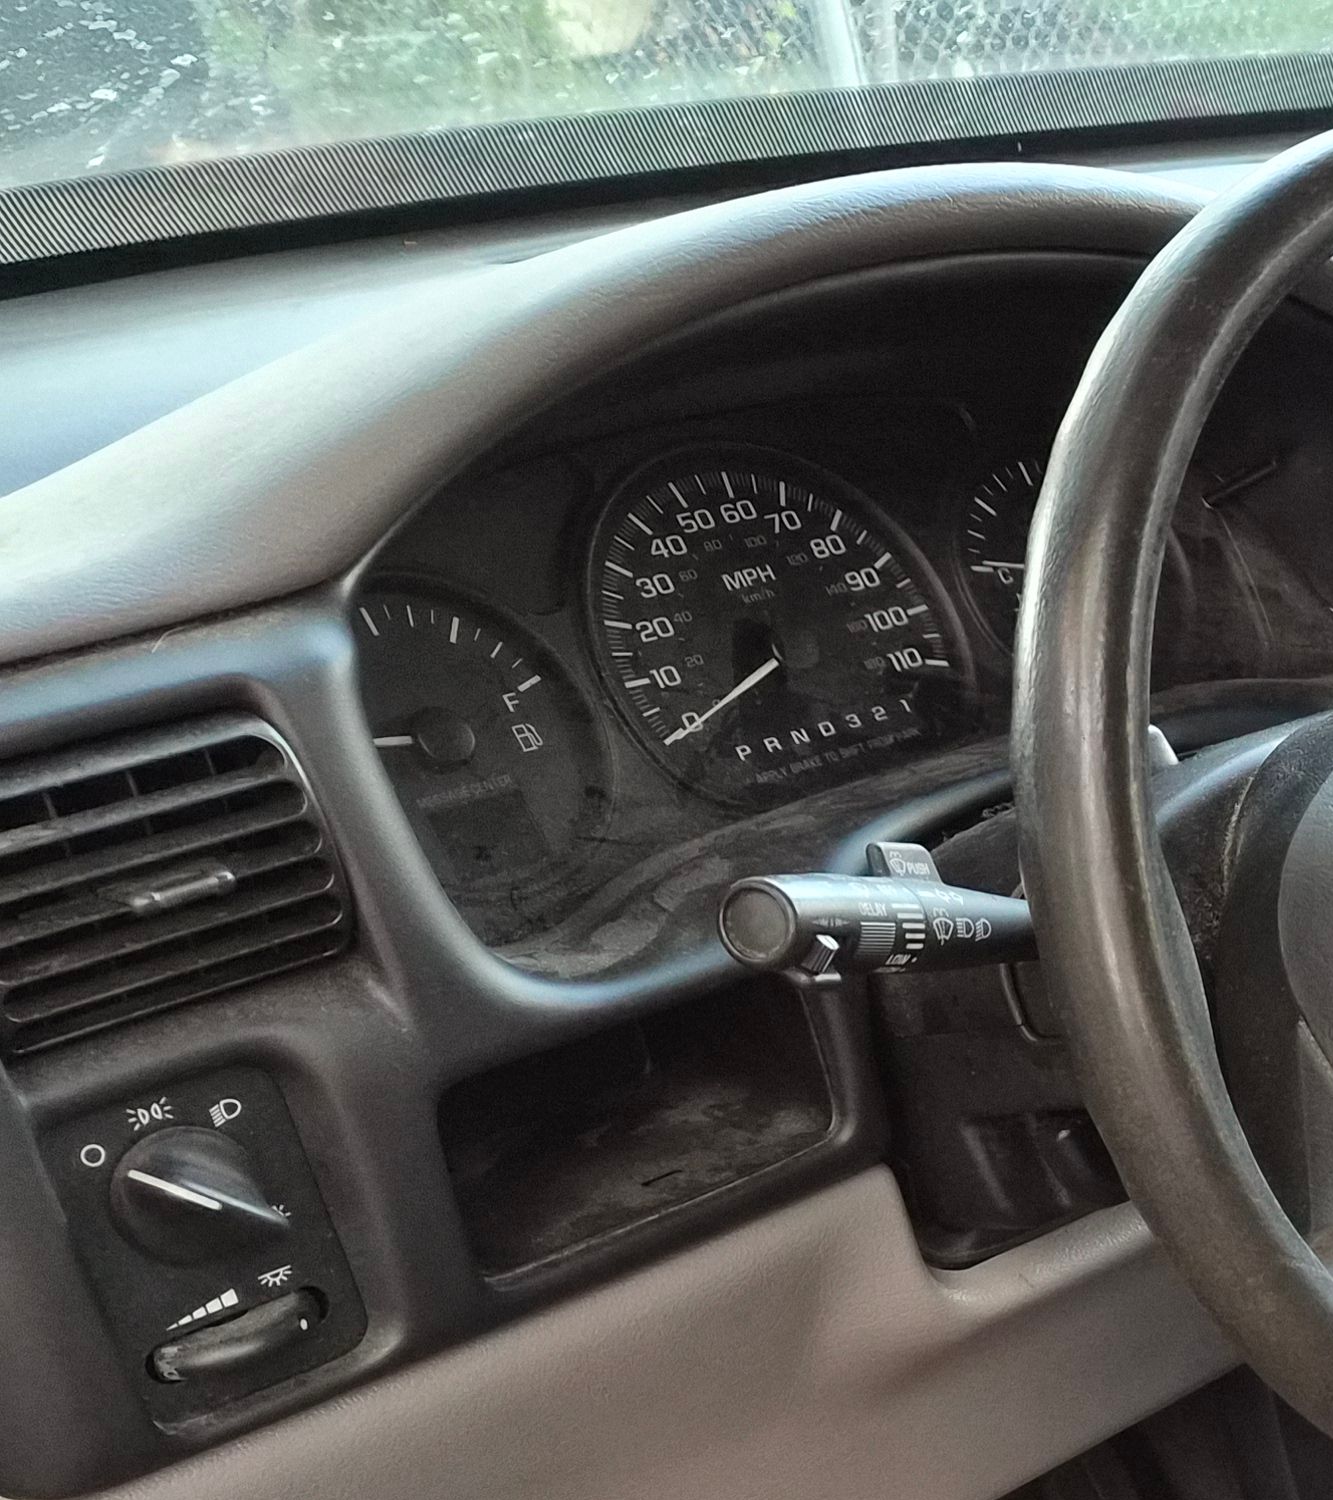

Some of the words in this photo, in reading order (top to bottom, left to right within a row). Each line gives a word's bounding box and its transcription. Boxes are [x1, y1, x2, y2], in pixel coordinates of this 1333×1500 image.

[676, 509, 715, 533] 50
[720, 500, 757, 524] 60
[764, 510, 802, 533] 70
[650, 535, 688, 559] 40
[744, 535, 767, 549] 100
[809, 534, 846, 559] 80
[635, 573, 675, 599] 30
[721, 564, 776, 592] MPH
[844, 567, 881, 592] 90
[743, 588, 775, 605] km/h
[674, 610, 693, 624] 40
[864, 606, 909, 632] 100
[635, 617, 675, 642] 20
[685, 654, 704, 668] 20
[887, 647, 924, 672] 110
[649, 665, 682, 688] 10
[502, 691, 519, 712] F
[681, 712, 703, 732] 0
[735, 744, 752, 761] P
[763, 736, 783, 753] R
[790, 728, 811, 745] N
[817, 721, 837, 737] D
[845, 714, 862, 728] 3
[871, 706, 888, 721] 2
[899, 699, 912, 713] 1
[907, 862, 930, 875] PUSH
[859, 902, 888, 917] DELAY
